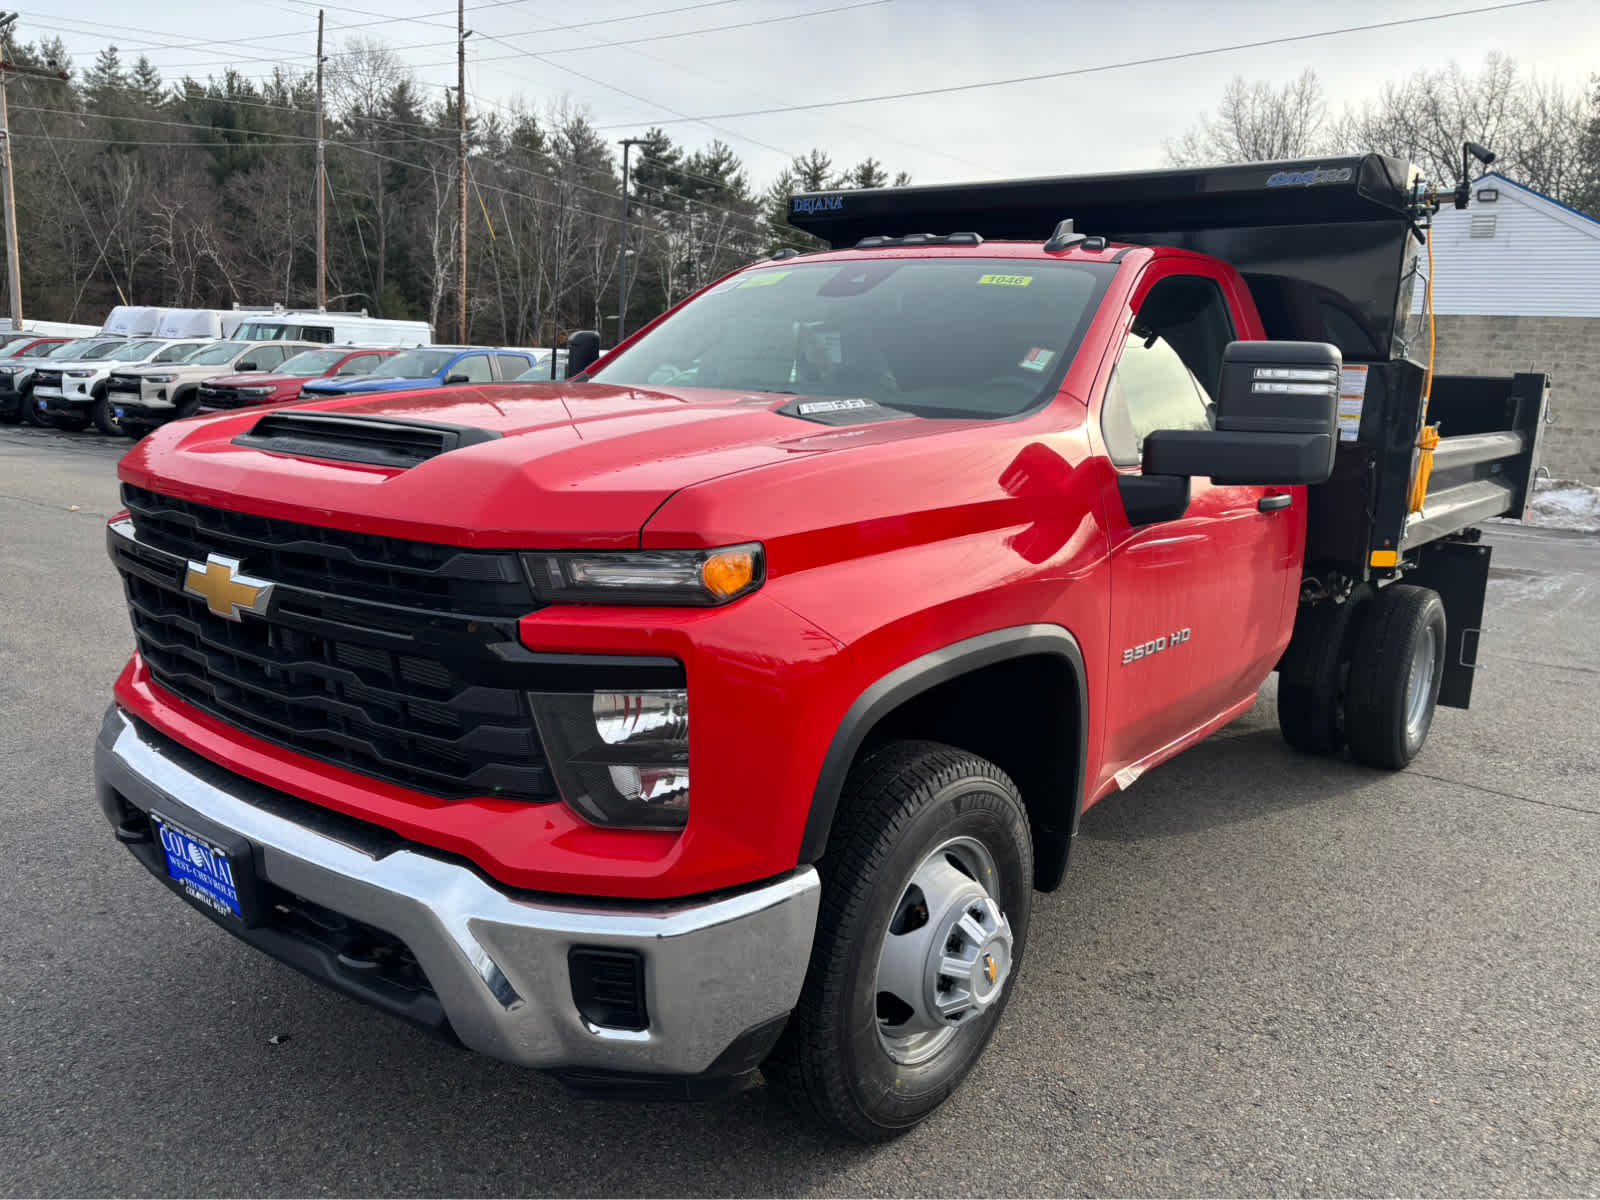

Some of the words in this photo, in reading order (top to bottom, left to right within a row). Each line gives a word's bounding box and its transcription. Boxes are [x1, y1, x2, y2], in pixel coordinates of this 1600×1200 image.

[793, 196, 843, 215] DEJANA
[1121, 636, 1167, 666] 3500
[1168, 627, 1191, 648] HD
[159, 827, 235, 892] COLONIAL
